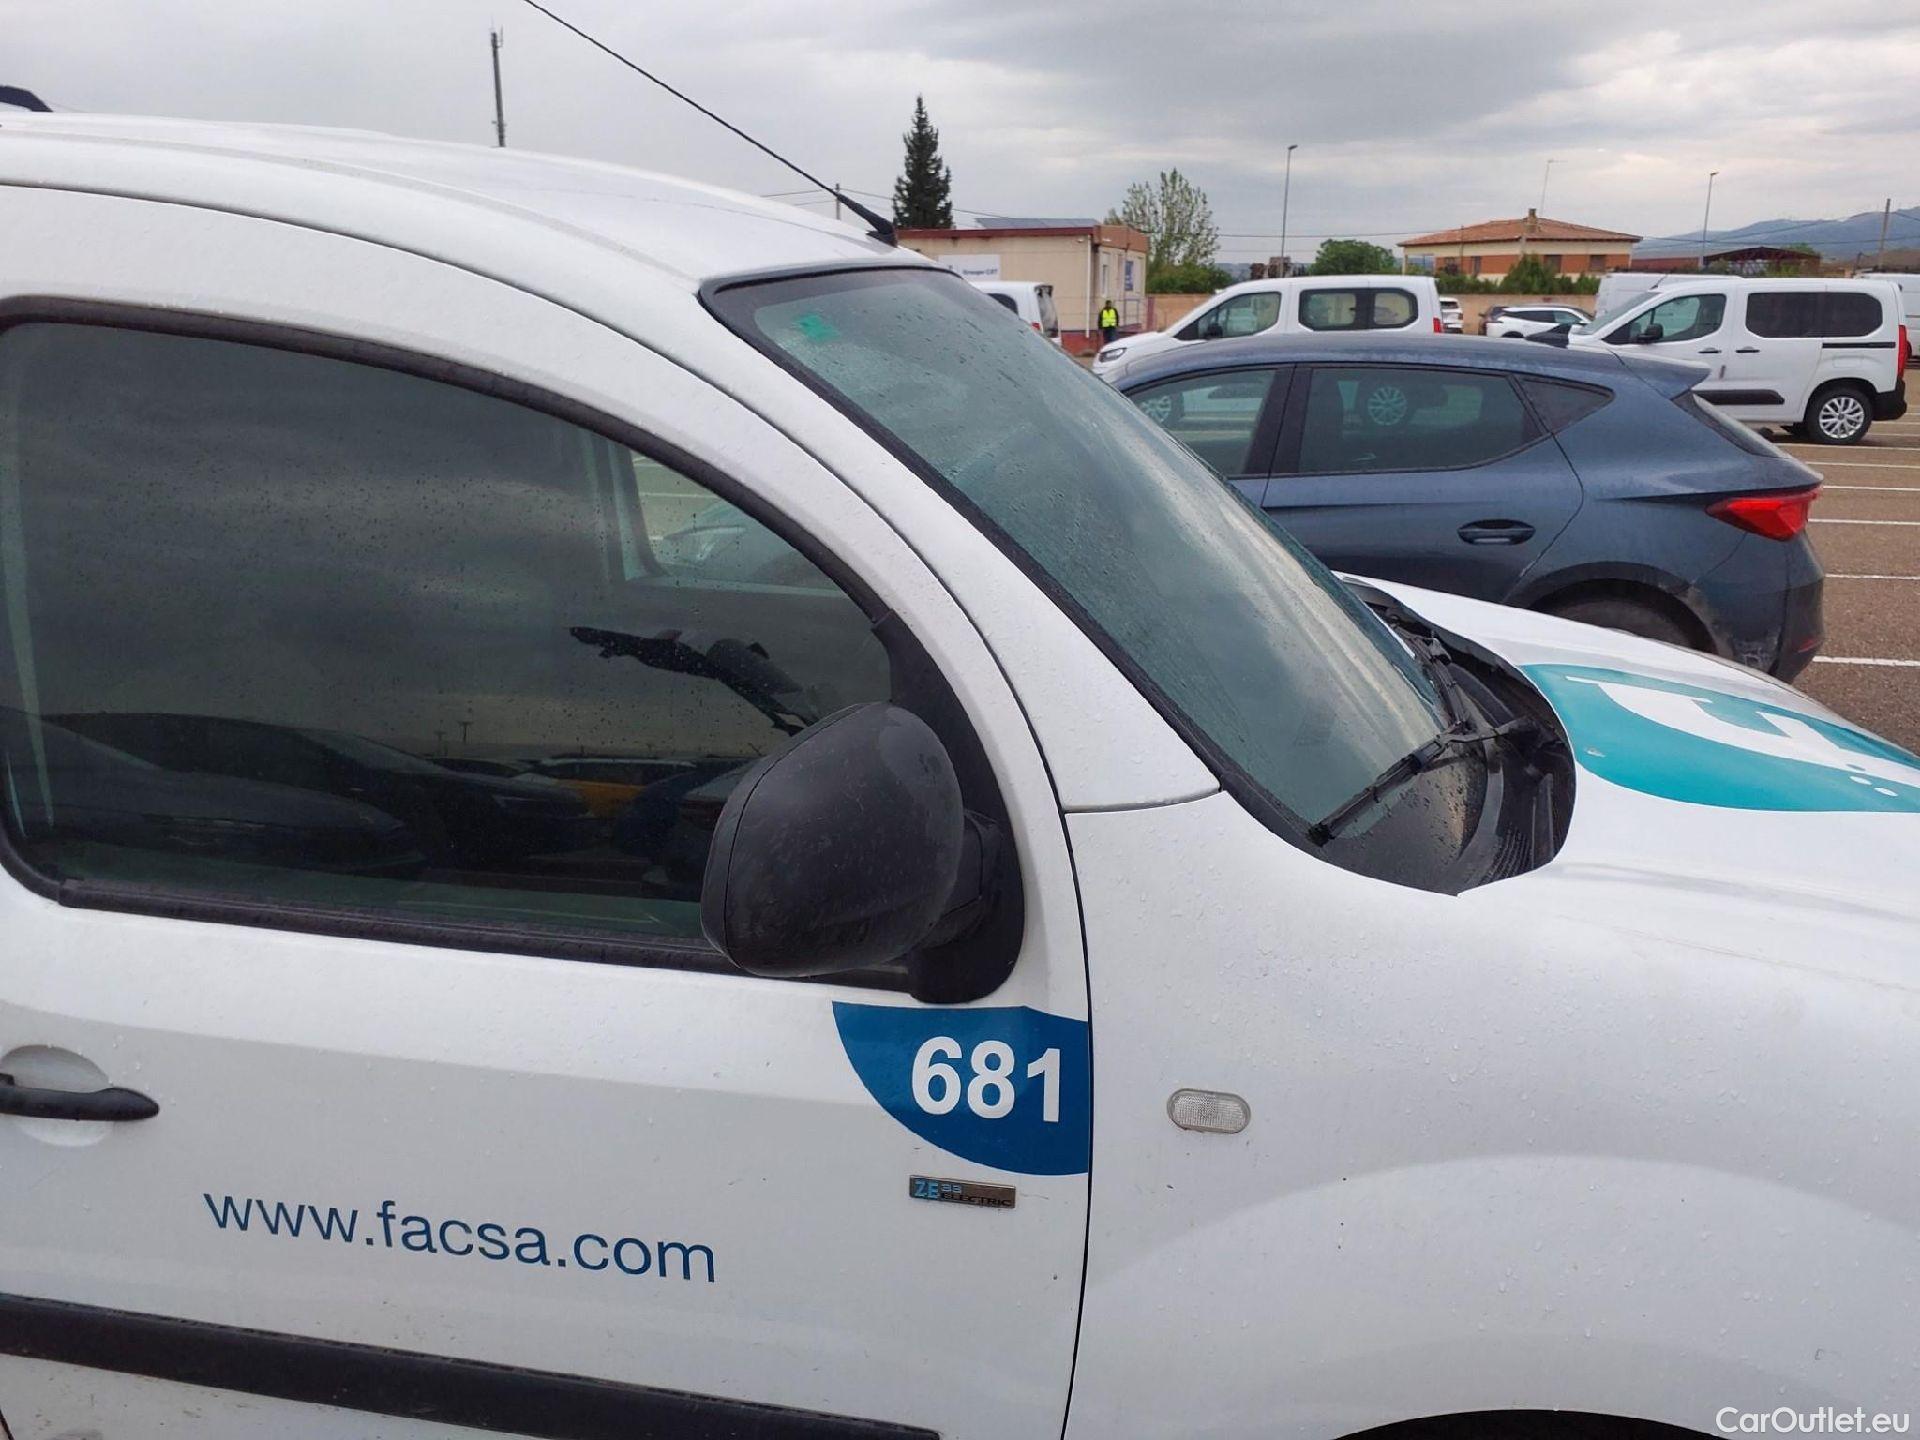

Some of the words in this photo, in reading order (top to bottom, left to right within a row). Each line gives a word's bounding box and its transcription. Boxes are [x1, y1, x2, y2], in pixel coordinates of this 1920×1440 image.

[911, 1035, 1061, 1123] 681
[914, 1179, 939, 1199] ZE
[202, 1192, 715, 1283] www.facsa.com
